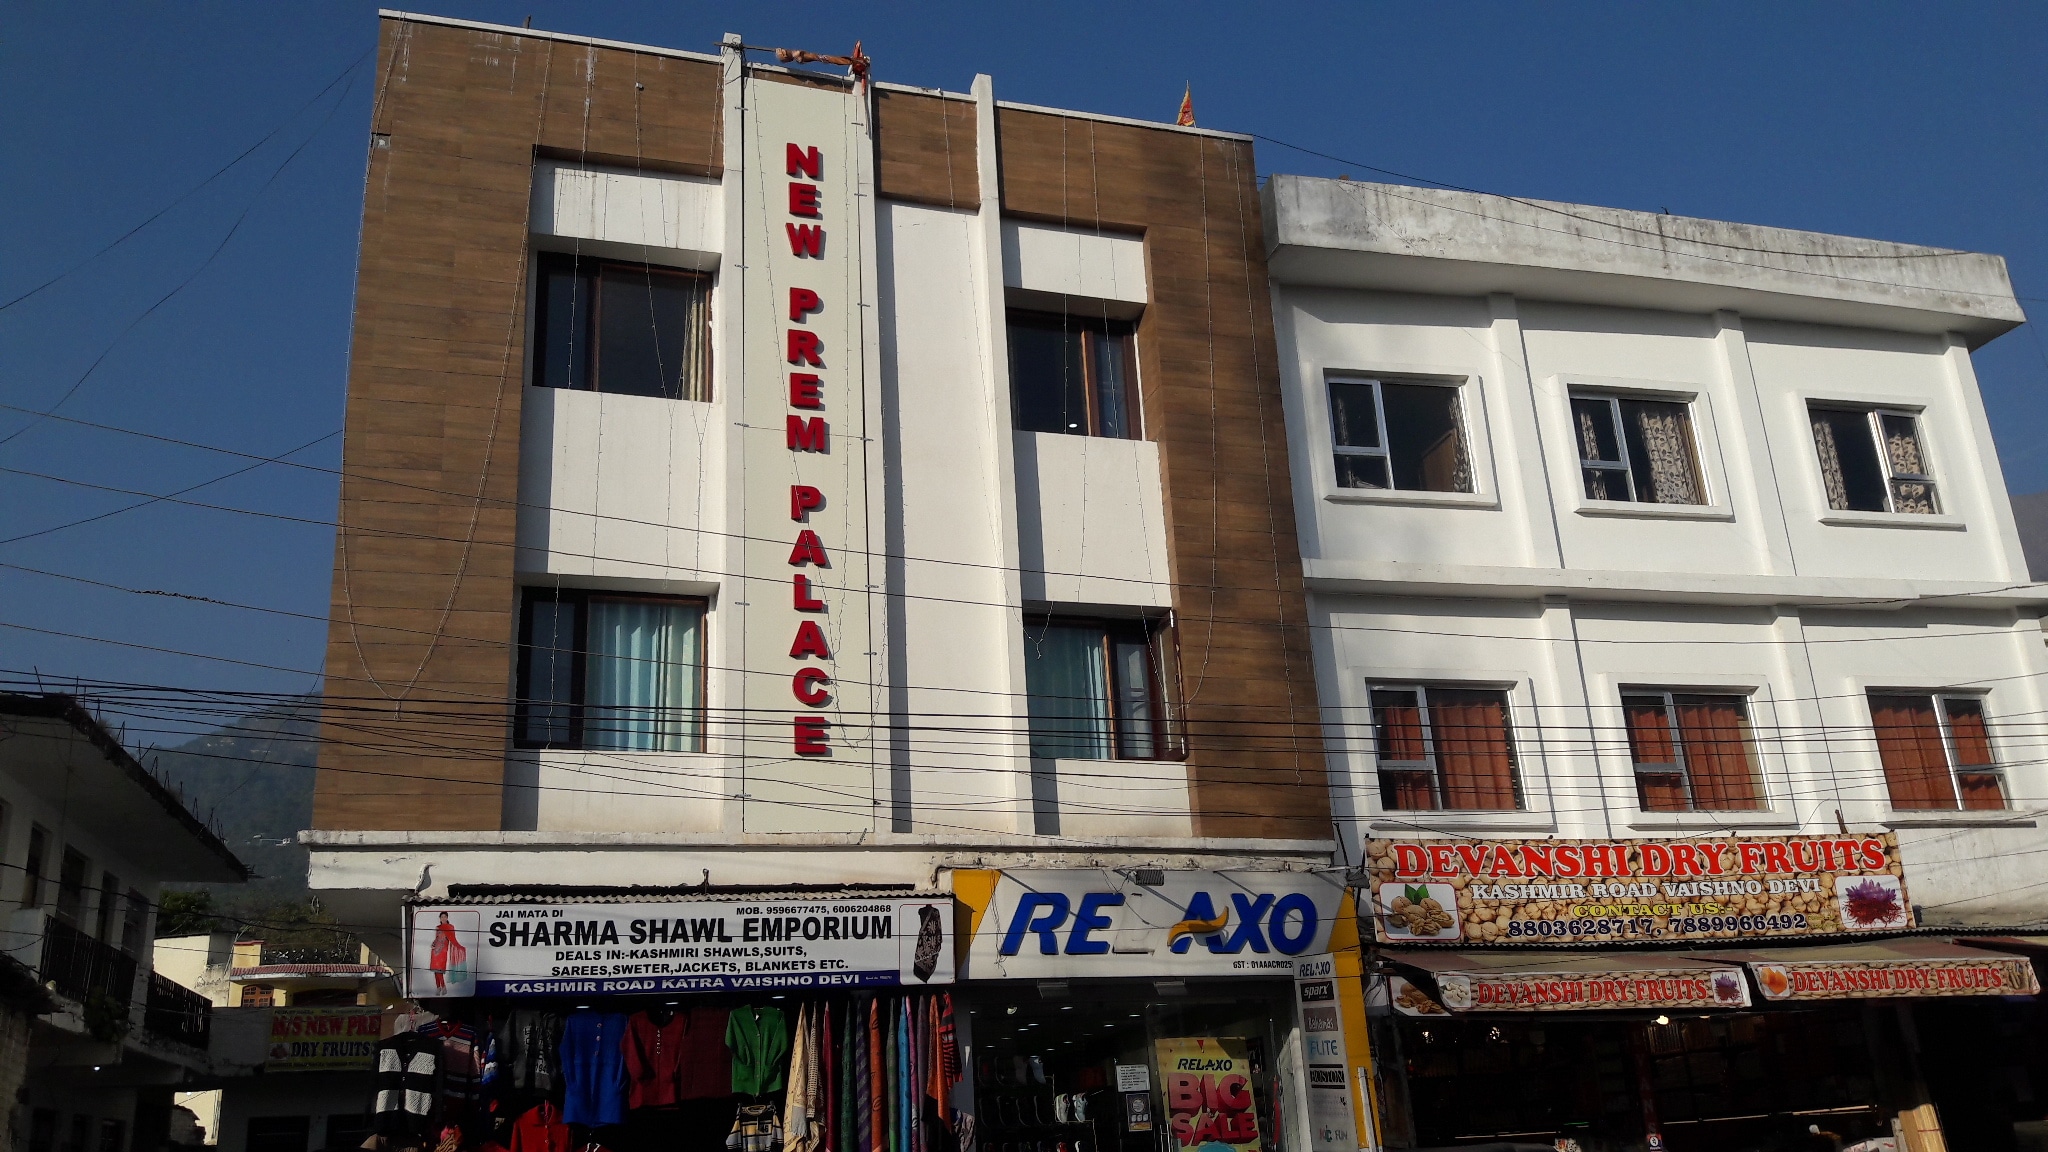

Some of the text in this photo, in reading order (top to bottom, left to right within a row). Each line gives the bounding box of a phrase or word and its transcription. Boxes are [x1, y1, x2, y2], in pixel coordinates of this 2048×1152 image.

[785, 143, 829, 757] NEW PREM PALACE
[1393, 838, 1886, 879] DEVANSHI DRY FRUITS
[1469, 877, 1822, 900] KASHMIR ROAD VAISHNO DEVI
[495, 909, 564, 919] JAI MATA DI
[736, 906, 763, 916] MOB.
[833, 904, 892, 914] 6006204868
[1572, 903, 1682, 917] CONTACT
[488, 915, 892, 948] SHARMA SHAWL EMPORIUM
[1508, 917, 1662, 938] 8803628717,
[1668, 913, 1808, 934] 7889966492
[555, 950, 602, 961] DEALS
[745, 959, 816, 972] BLANKETS
[820, 958, 849, 970] ETC.
[1299, 961, 1331, 977] RELAXO
[1790, 967, 2003, 992] DEVANSHI DRY FRUITS
[504, 981, 597, 994] KASHMIR
[603, 980, 656, 992] ROAD
[661, 978, 725, 990] KATRA
[731, 974, 813, 988] VAISHNO
[818, 973, 860, 985] DEVI
[1303, 983, 1330, 997] sparx
[1477, 979, 1709, 1005] DEVANSHI DRY FRUITS
[304, 1014, 344, 1036] NEW
[290, 1041, 320, 1057] DRY
[321, 1041, 371, 1057] FRUITS
[1177, 1058, 1233, 1072] RELAXO
[1168, 1072, 1252, 1116] BIG
[1171, 1112, 1259, 1147] SALE
